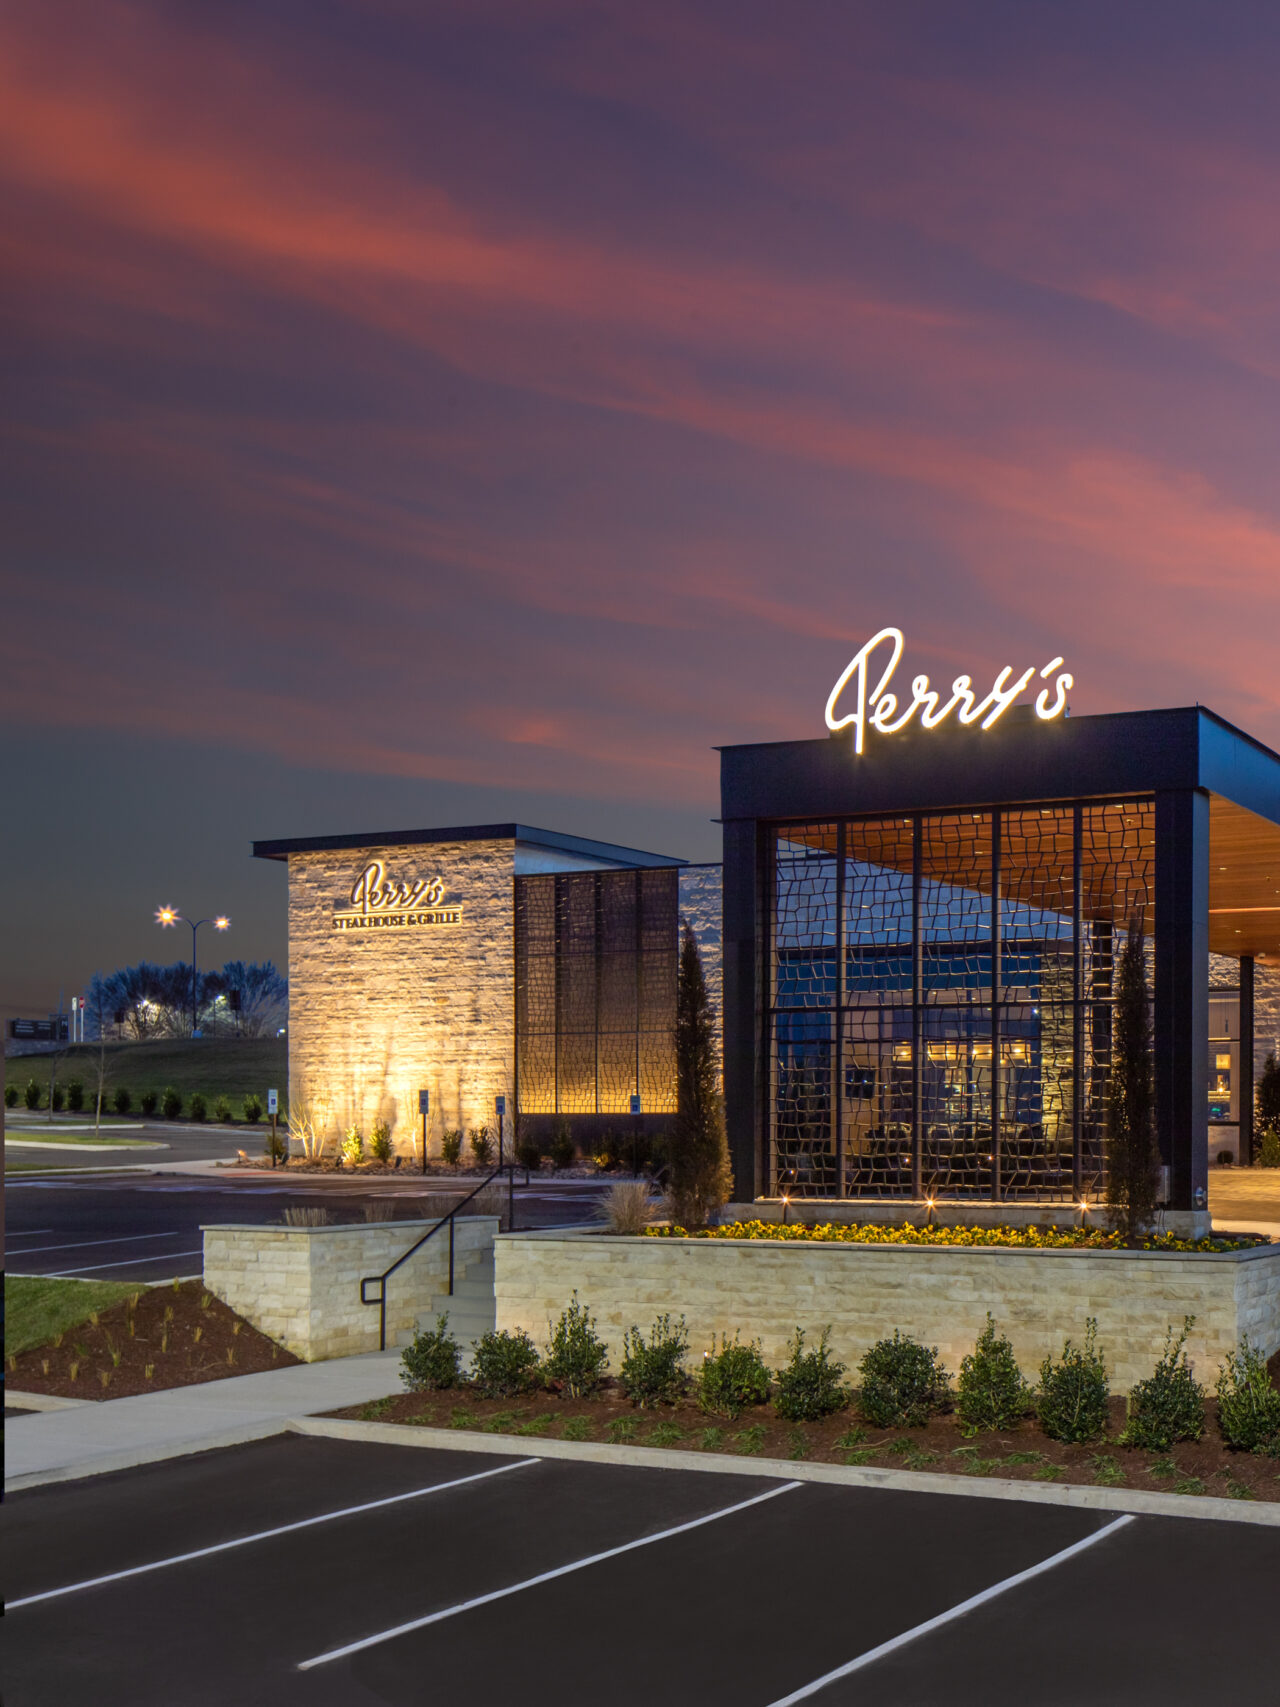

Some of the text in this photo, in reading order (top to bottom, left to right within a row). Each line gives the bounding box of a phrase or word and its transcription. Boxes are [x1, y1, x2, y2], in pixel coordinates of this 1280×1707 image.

[825, 627, 1073, 754] Perry's
[351, 863, 442, 914] Perry's
[332, 912, 460, 929] STEAKHOUSE & GRILLE
